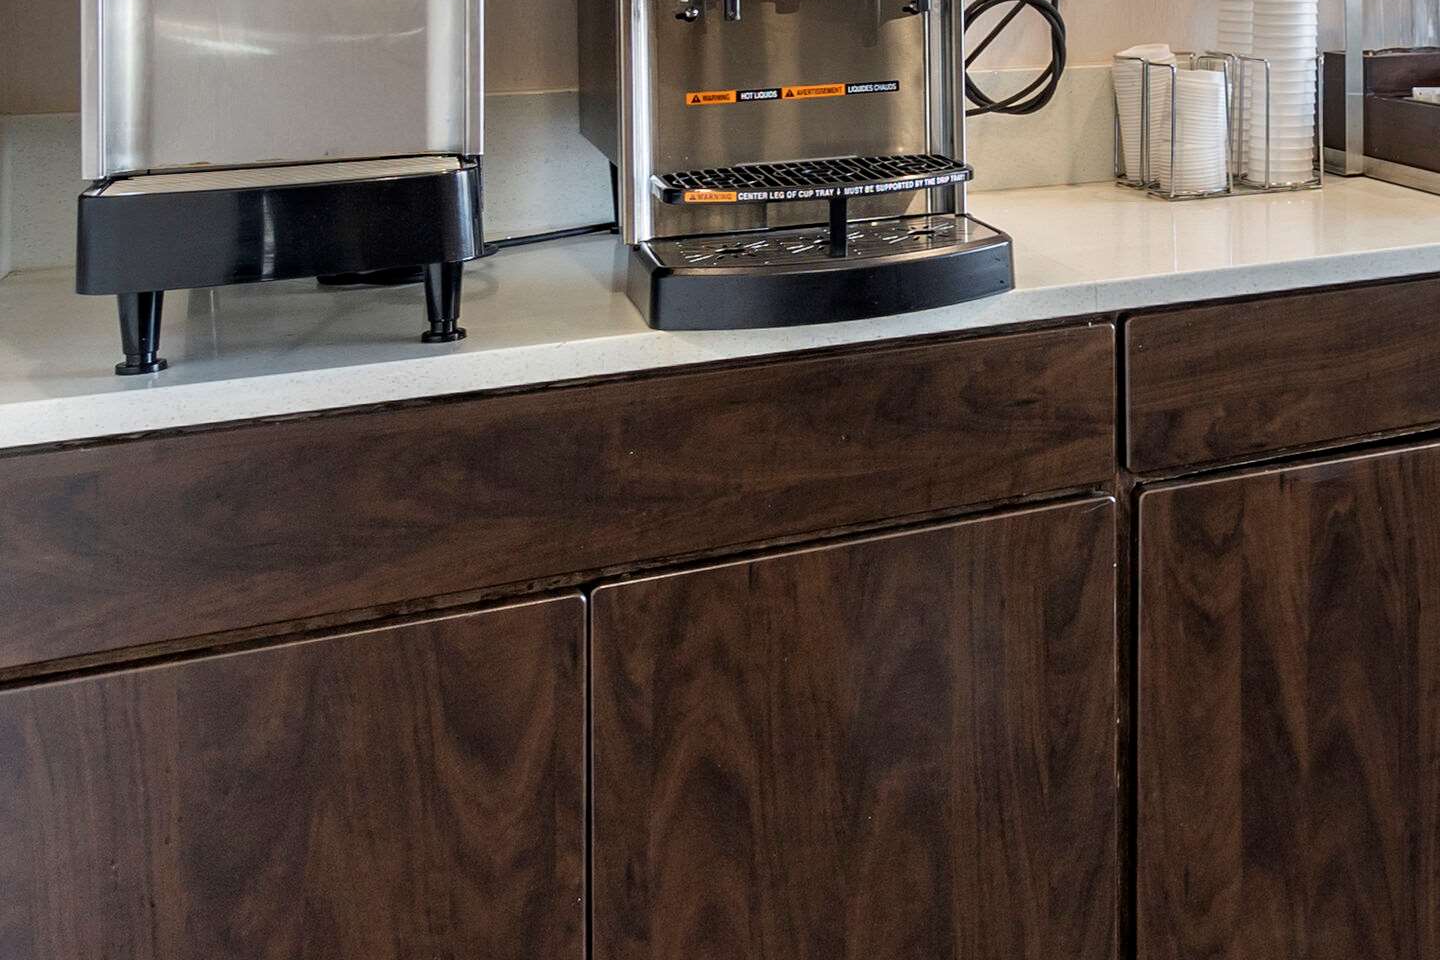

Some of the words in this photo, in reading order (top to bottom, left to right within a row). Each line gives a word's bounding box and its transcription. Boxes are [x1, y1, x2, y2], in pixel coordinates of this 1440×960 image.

[702, 93, 731, 102] WARNING
[740, 92, 753, 100] HOT
[754, 90, 778, 99] LIQUIDS
[738, 192, 769, 201] CENTER
[769, 191, 785, 199] LEG
[786, 190, 796, 198] OF
[798, 190, 813, 198] CUP
[815, 188, 834, 197] TRAY
[844, 185, 864, 194] MUST
[864, 185, 875, 193] BE
[875, 181, 914, 192] SUPPORTED
[915, 179, 924, 188] BY
[924, 177, 936, 186] THE
[936, 175, 950, 185] DRIP
